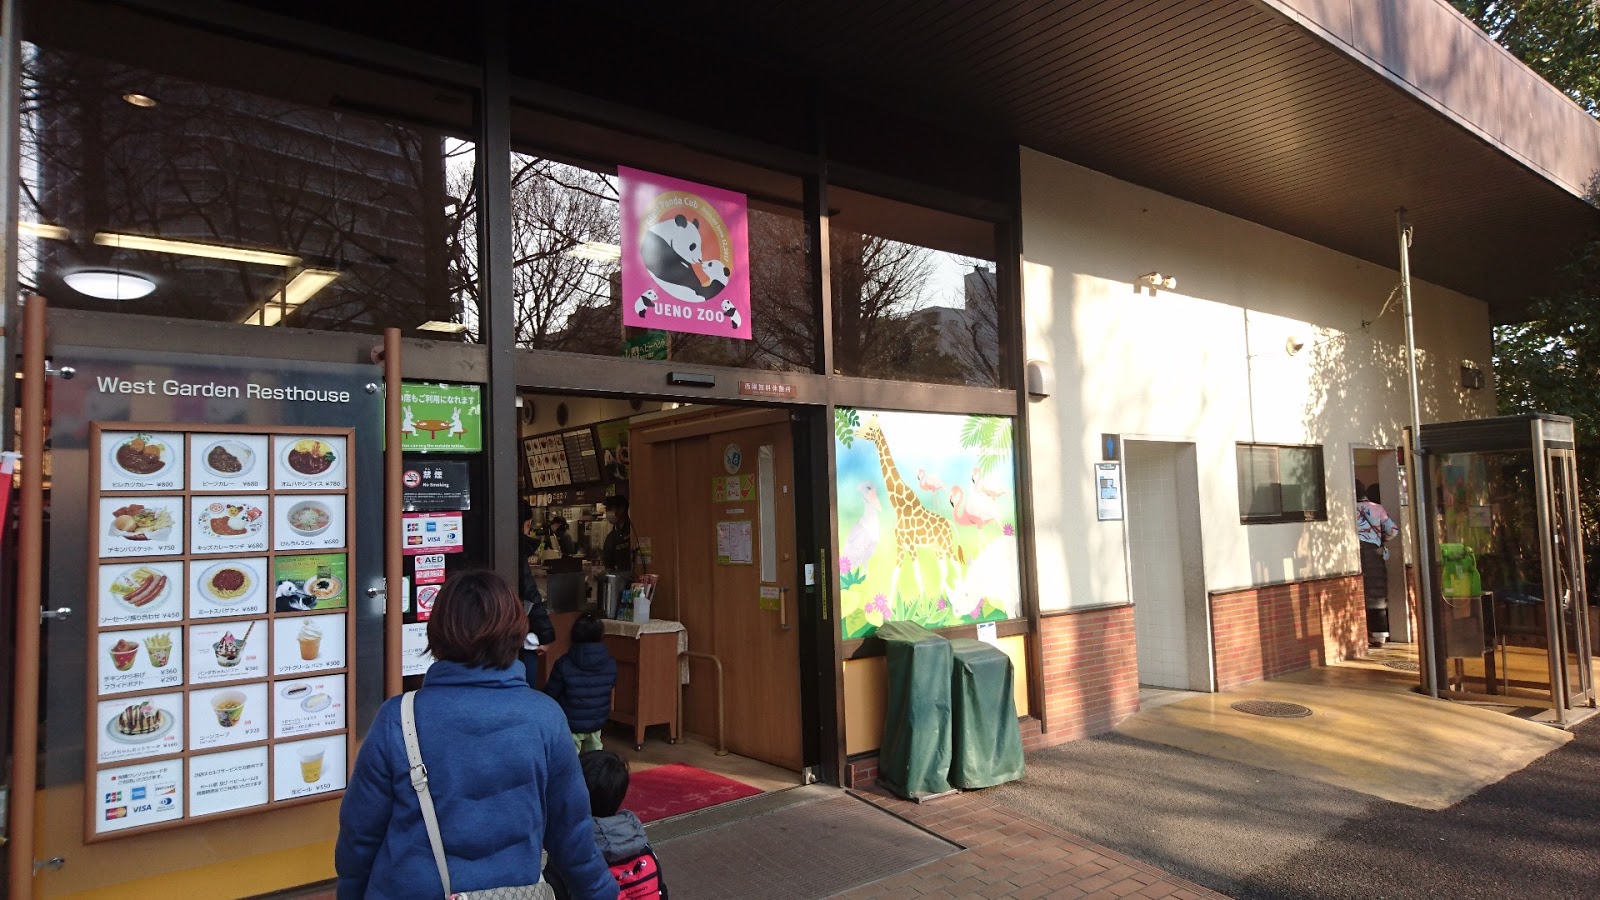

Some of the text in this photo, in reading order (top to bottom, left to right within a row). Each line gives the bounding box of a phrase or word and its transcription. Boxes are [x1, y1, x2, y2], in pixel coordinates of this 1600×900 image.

[659, 196, 682, 207] Panda
[684, 197, 698, 208] Cub
[654, 302, 725, 323] UENO ZOO
[97, 376, 350, 402] West Garden Resthouse
[423, 470, 443, 479] 禁煙
[425, 556, 443, 564] AED
[291, 787, 312, 795] 生ビール
[133, 804, 152, 813] VISA
